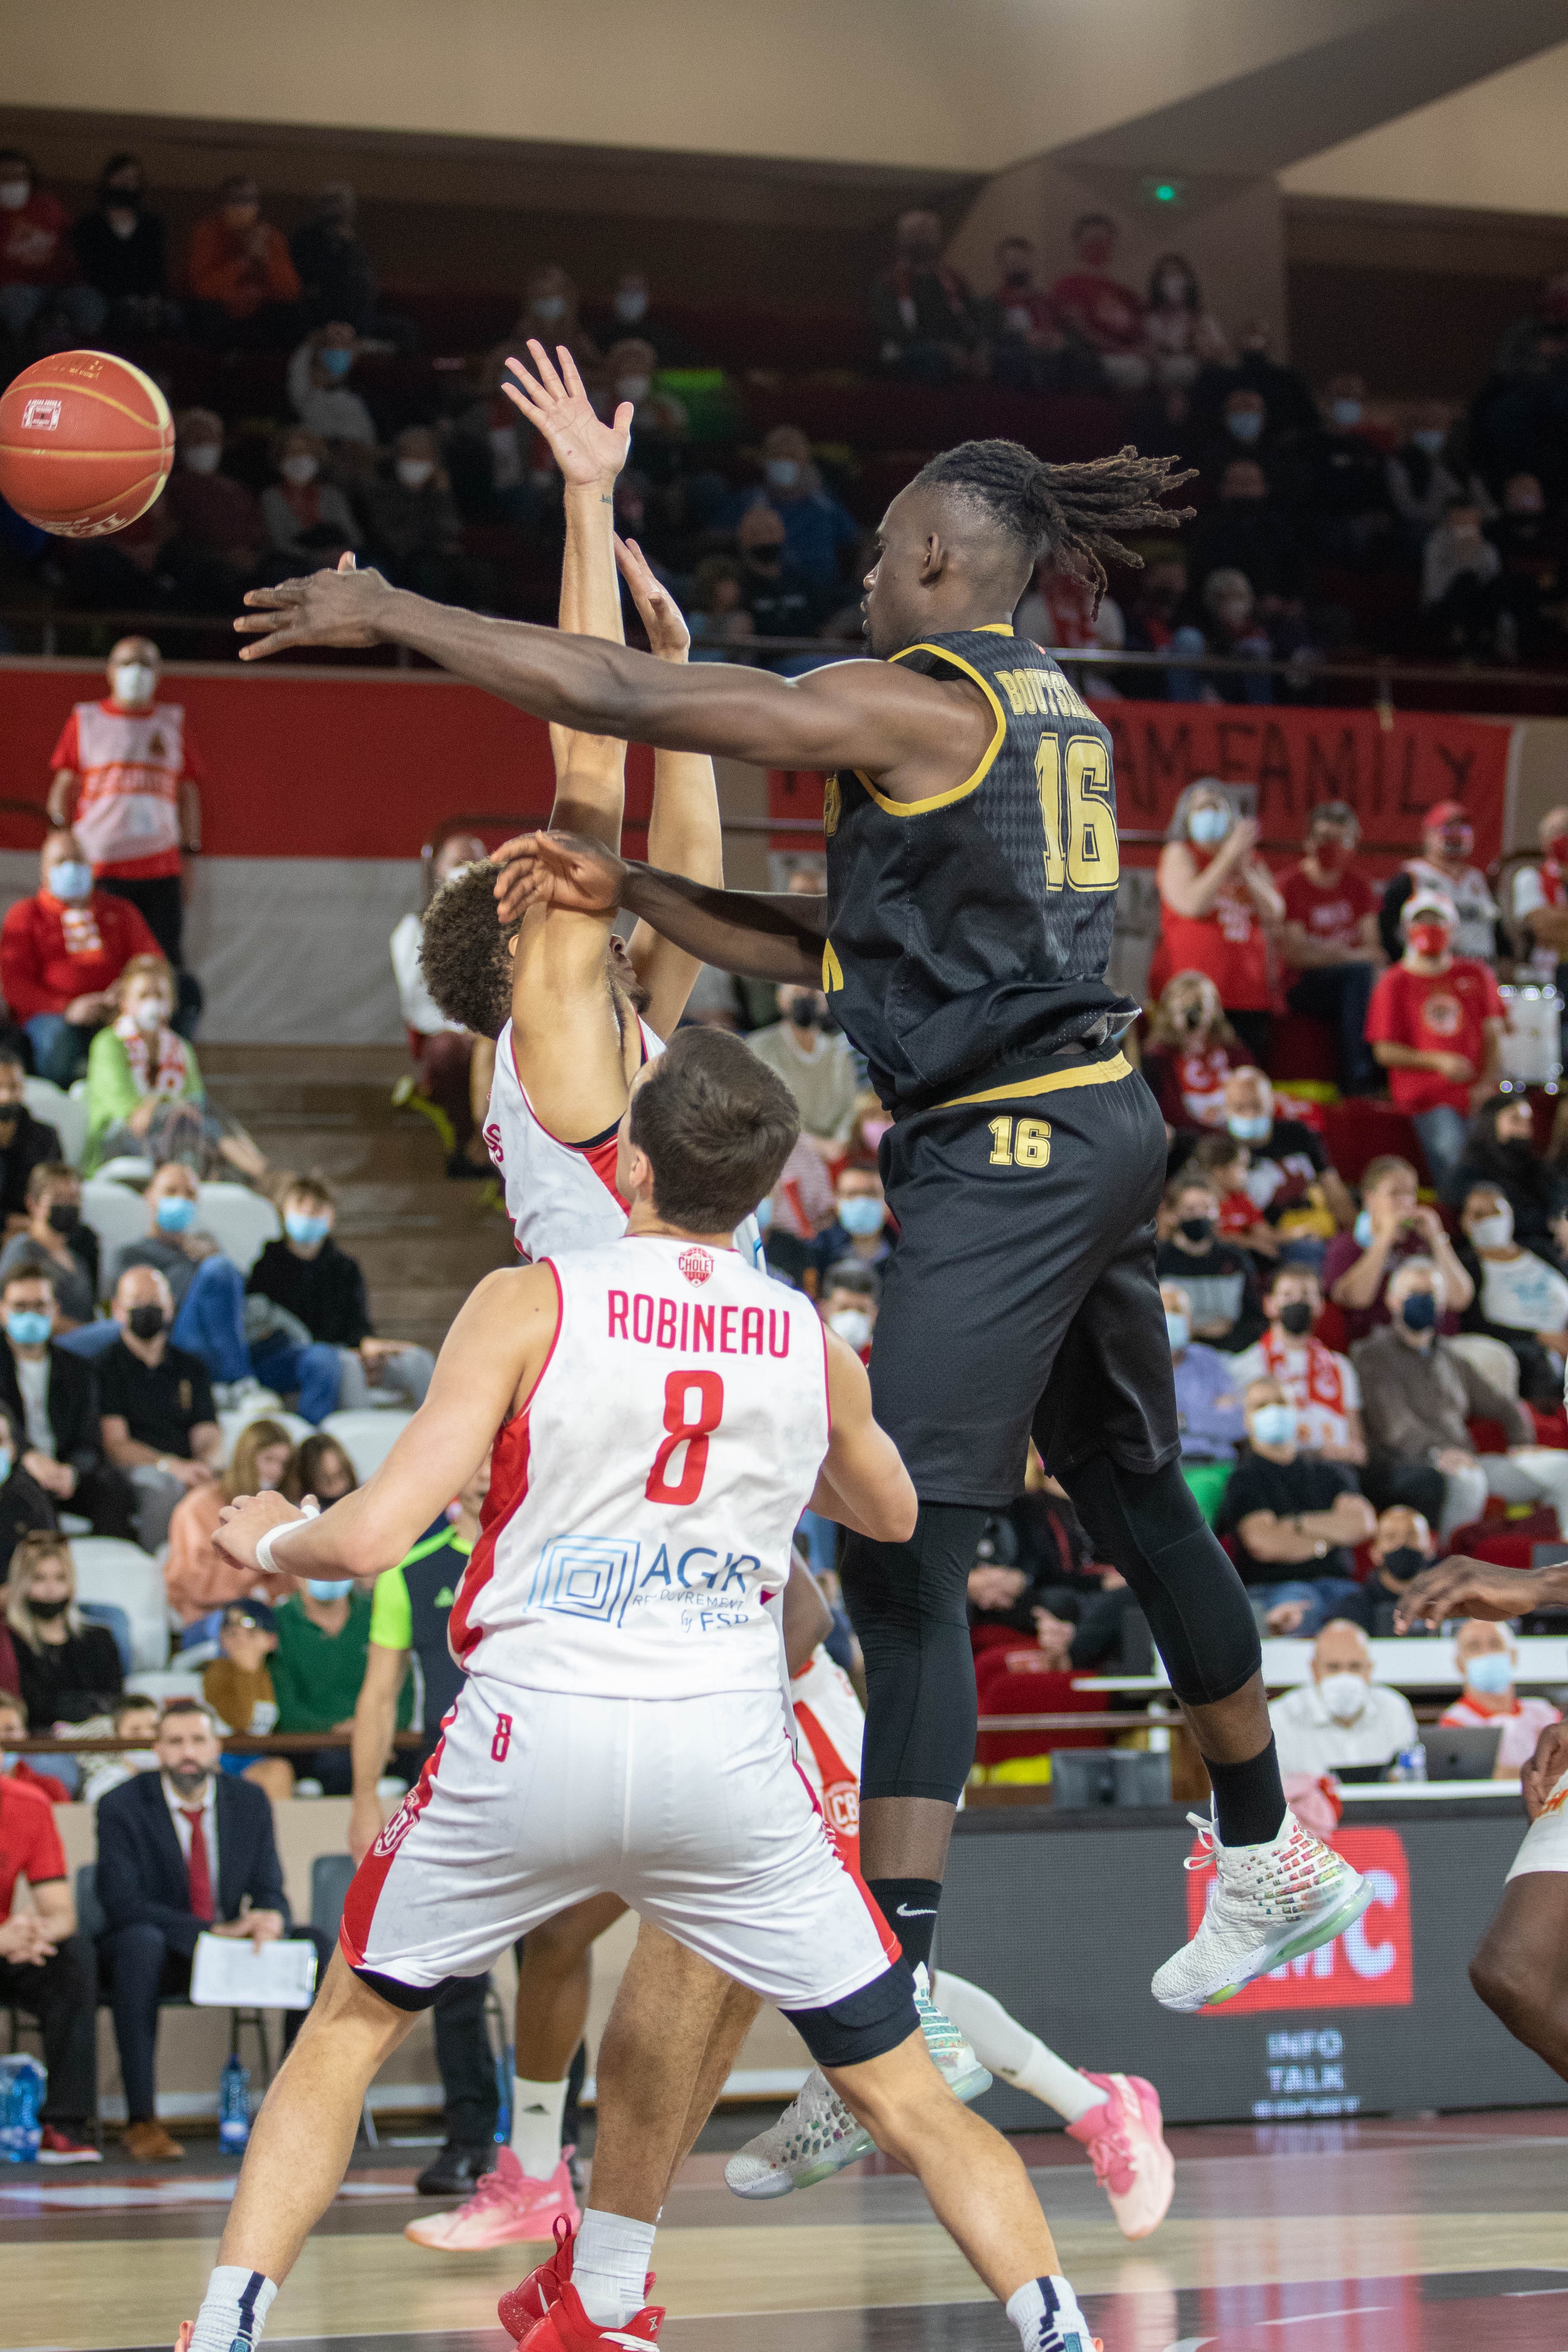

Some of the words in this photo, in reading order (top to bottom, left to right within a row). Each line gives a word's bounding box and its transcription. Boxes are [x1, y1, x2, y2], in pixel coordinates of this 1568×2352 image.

[1034, 732, 1119, 892] 16
[988, 1116, 1051, 1168] 16
[678, 1256, 715, 1273] CHOLET
[608, 1290, 790, 1358] ROBINEAU
[645, 1370, 724, 1505] 8
[632, 1589, 744, 1611] REOUVREMENT
[681, 1609, 692, 1633] by
[491, 1712, 513, 1763] 8
[832, 1792, 860, 1824] CB
[1268, 2064, 1344, 2092] TALK
